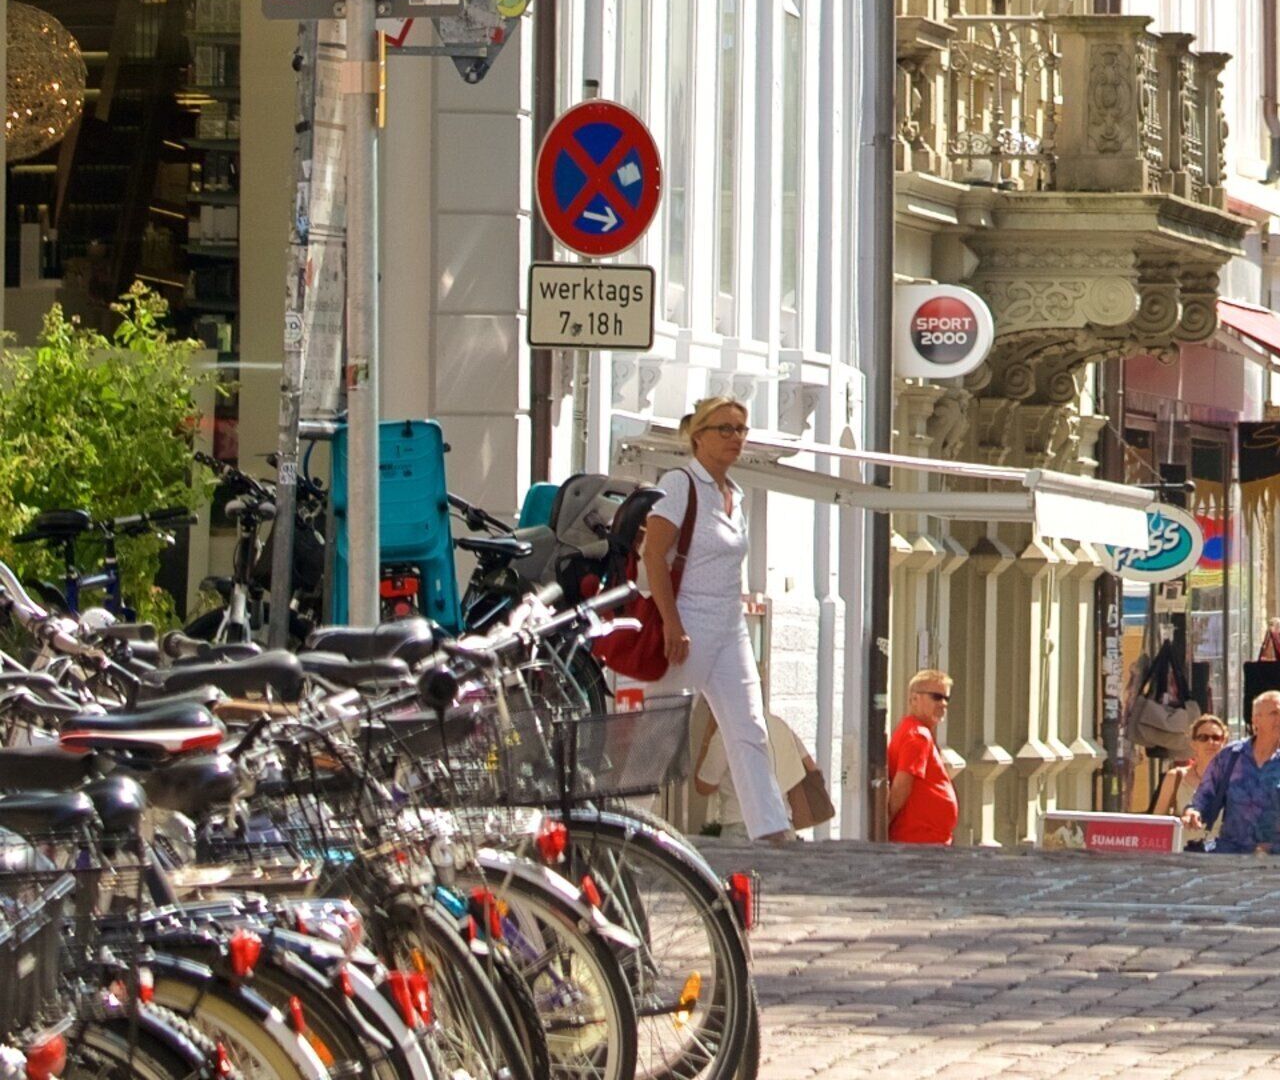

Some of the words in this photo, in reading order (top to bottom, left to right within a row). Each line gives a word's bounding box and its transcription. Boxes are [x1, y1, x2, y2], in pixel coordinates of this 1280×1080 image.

[540, 277, 644, 308] werktags
[916, 317, 971, 331] SPORT
[921, 331, 967, 345] 2000
[1090, 834, 1139, 848] SUMMER
[1141, 837, 1169, 849] SALE
